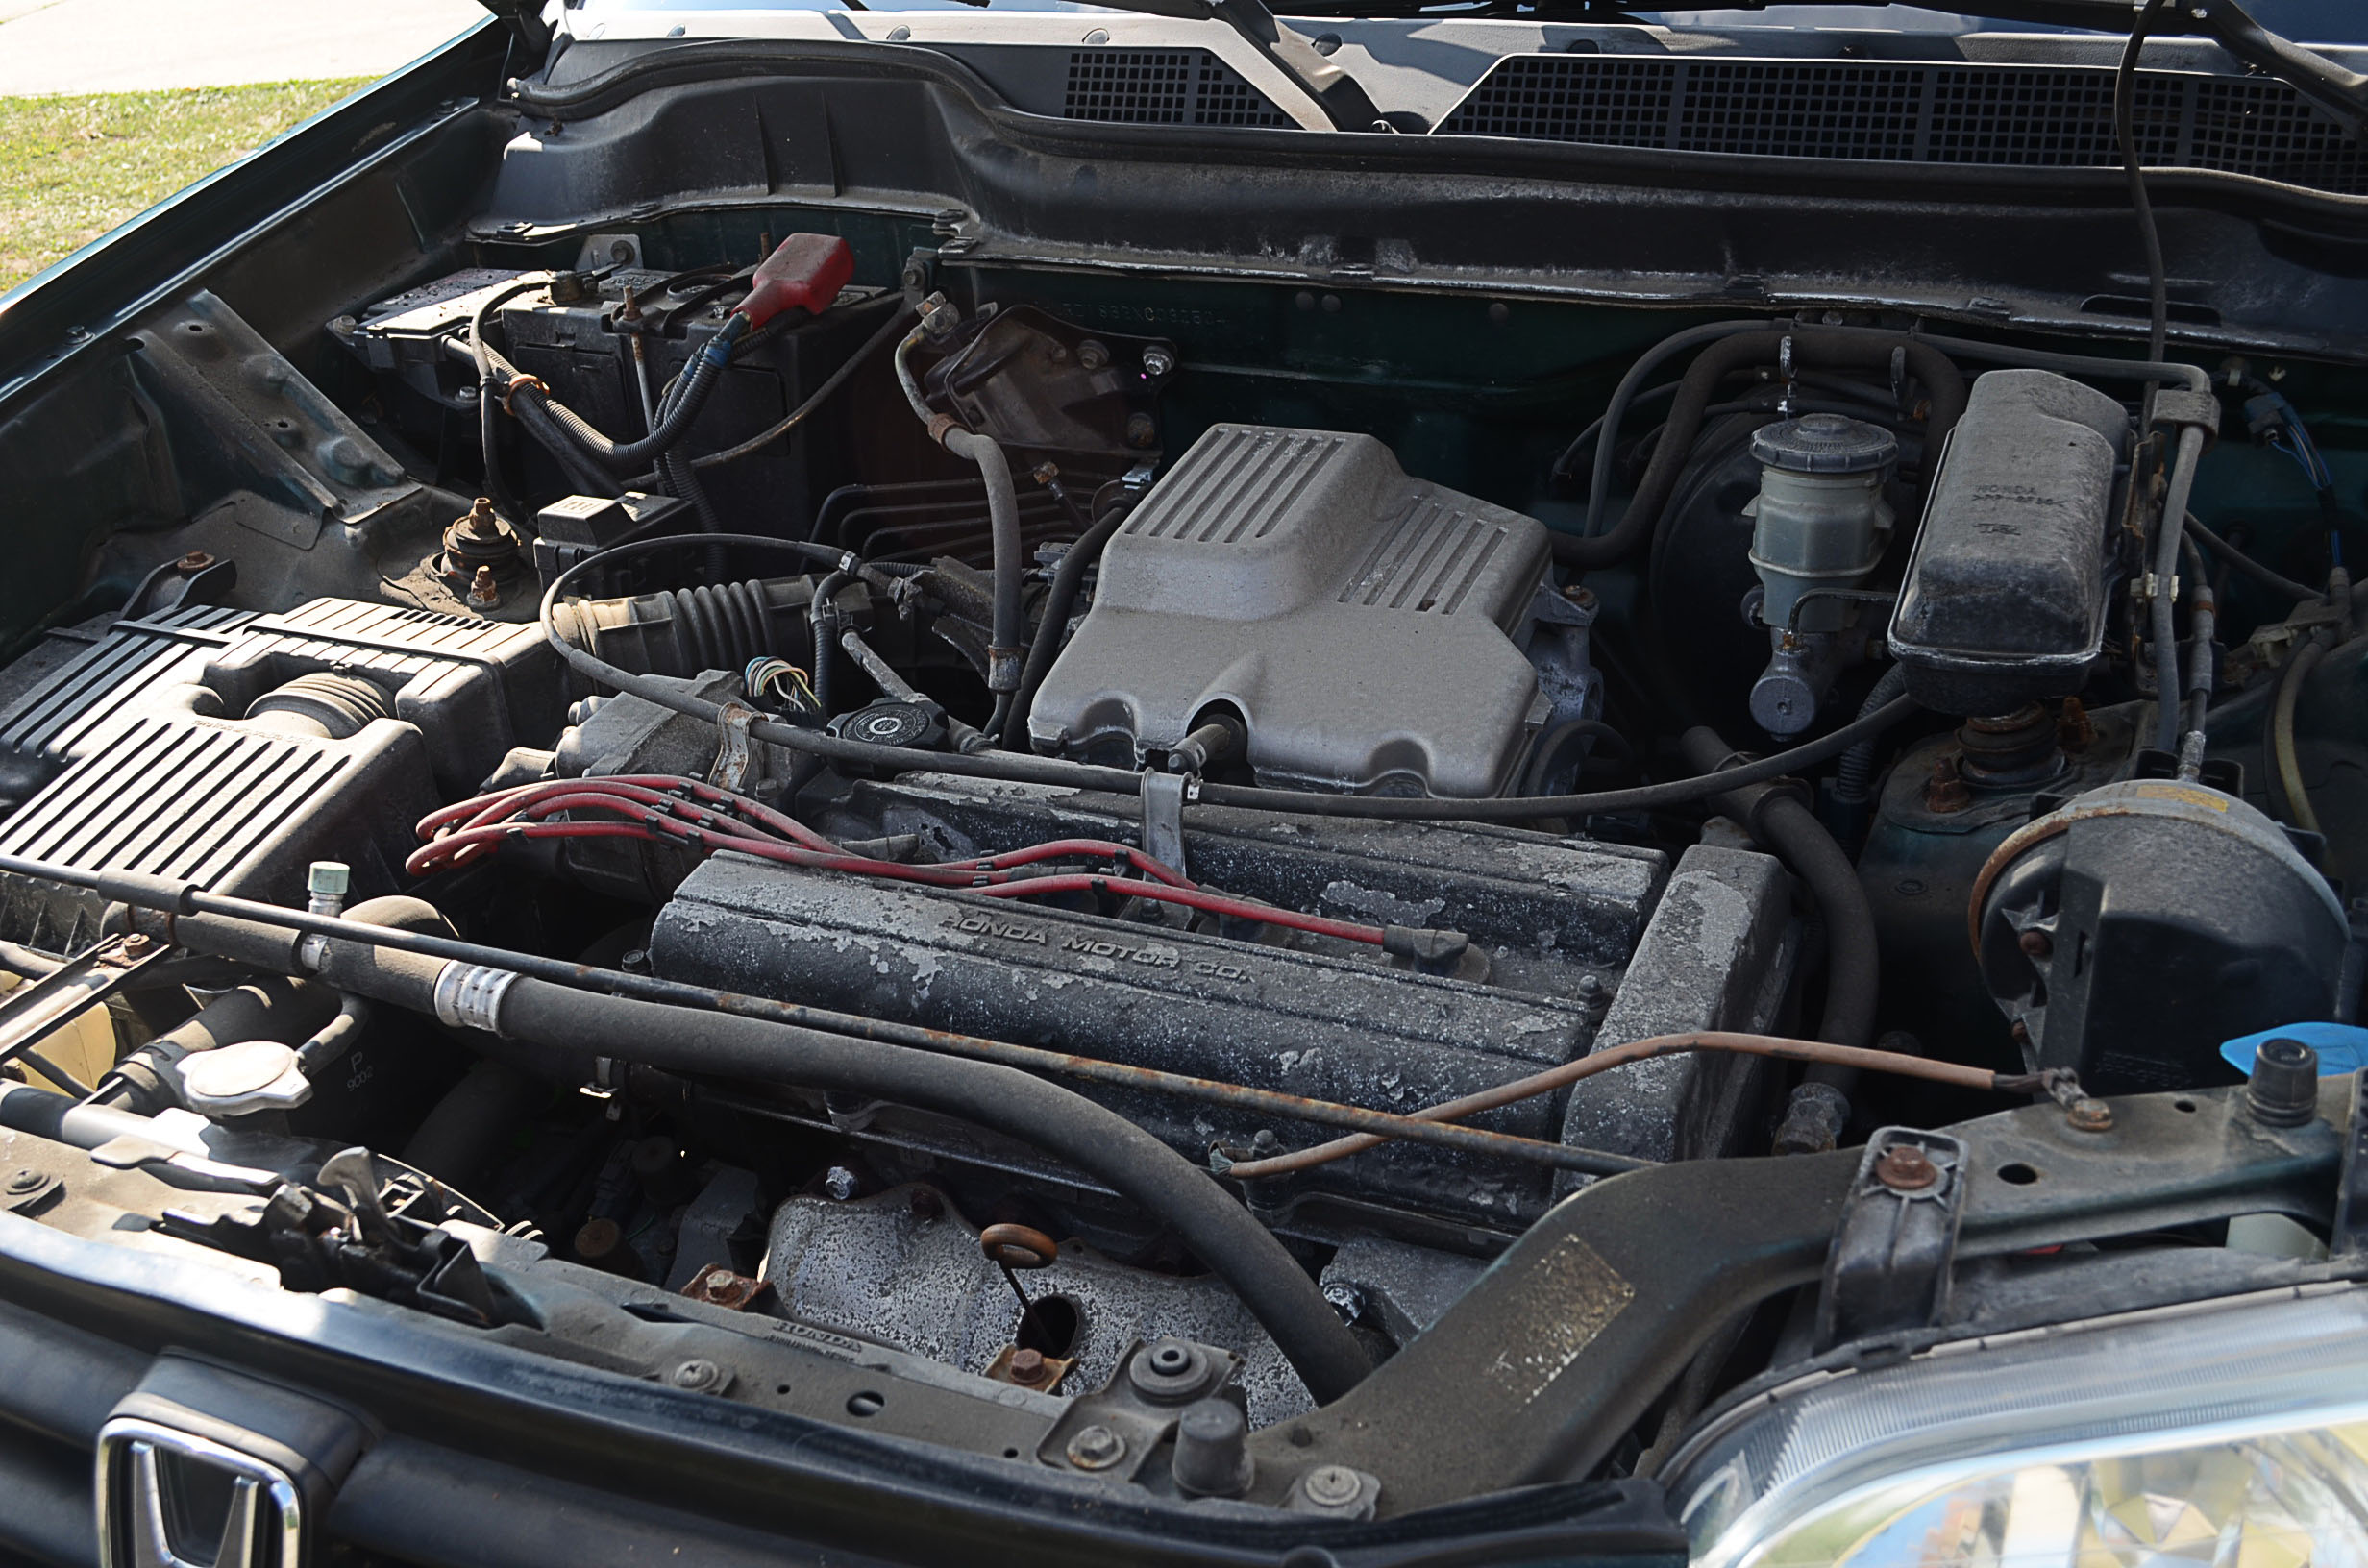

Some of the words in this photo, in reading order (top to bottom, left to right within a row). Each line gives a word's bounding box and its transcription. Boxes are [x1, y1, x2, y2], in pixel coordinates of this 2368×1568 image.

[1977, 484, 2036, 495] HONDA
[938, 916, 1048, 944] HONDA
[1061, 936, 1181, 968] MOTOR
[350, 1051, 363, 1074] P
[772, 1320, 862, 1354] HONDA
